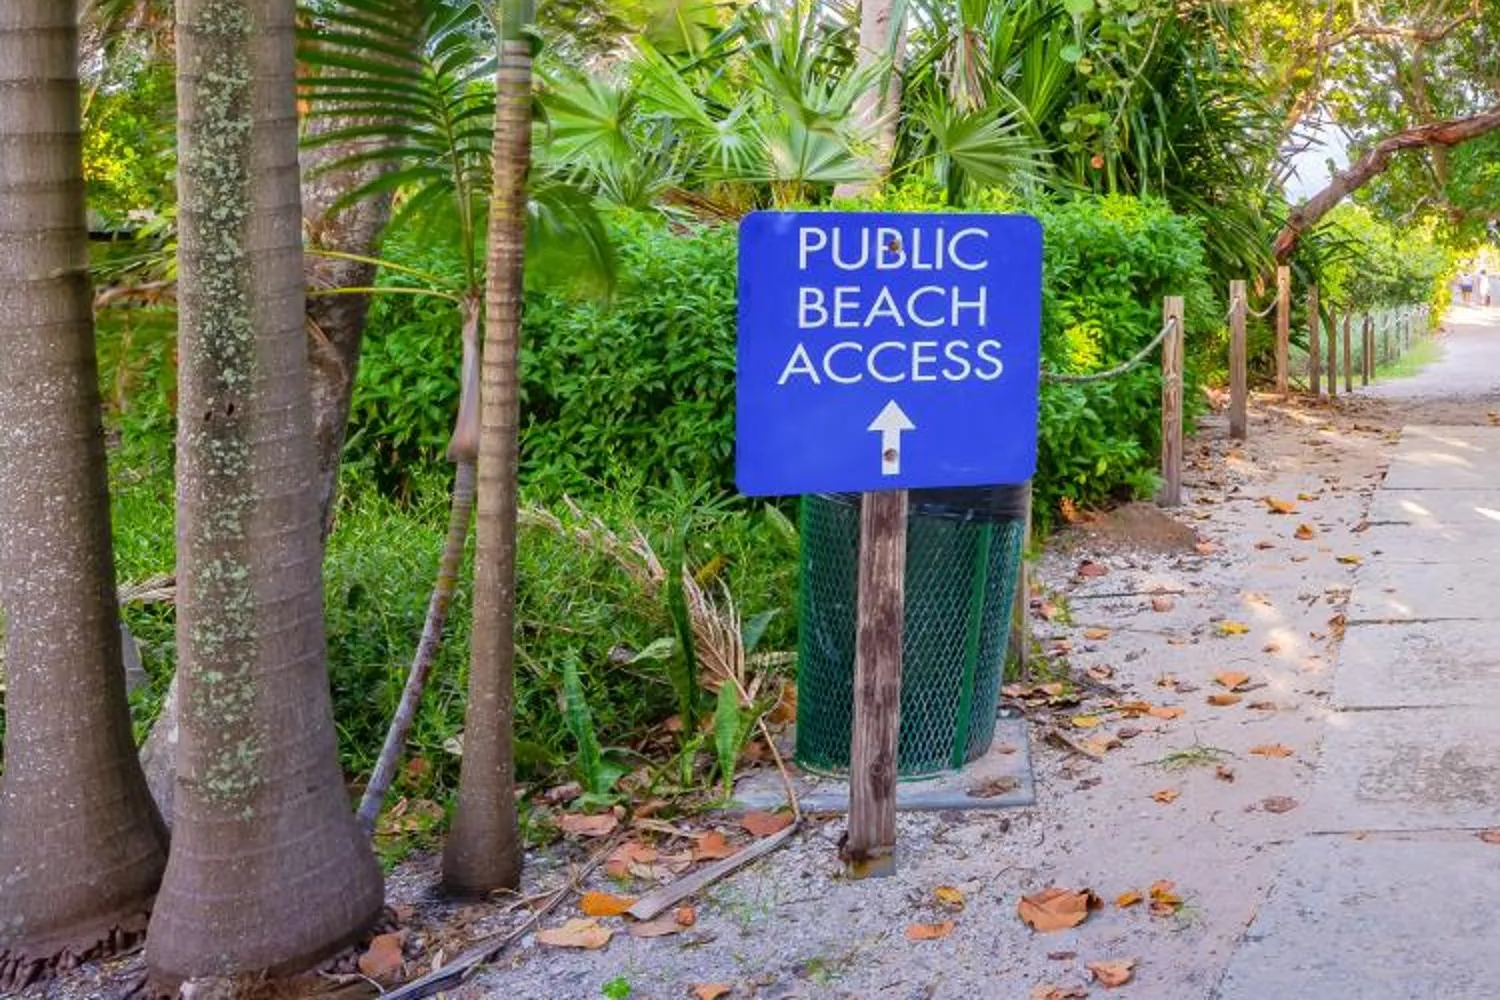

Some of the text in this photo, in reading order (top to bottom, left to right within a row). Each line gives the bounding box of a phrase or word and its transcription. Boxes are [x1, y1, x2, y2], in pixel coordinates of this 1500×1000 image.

[798, 226, 990, 272] PUBLIC
[798, 285, 988, 329] BEACH
[776, 340, 1005, 386] ACCESS
